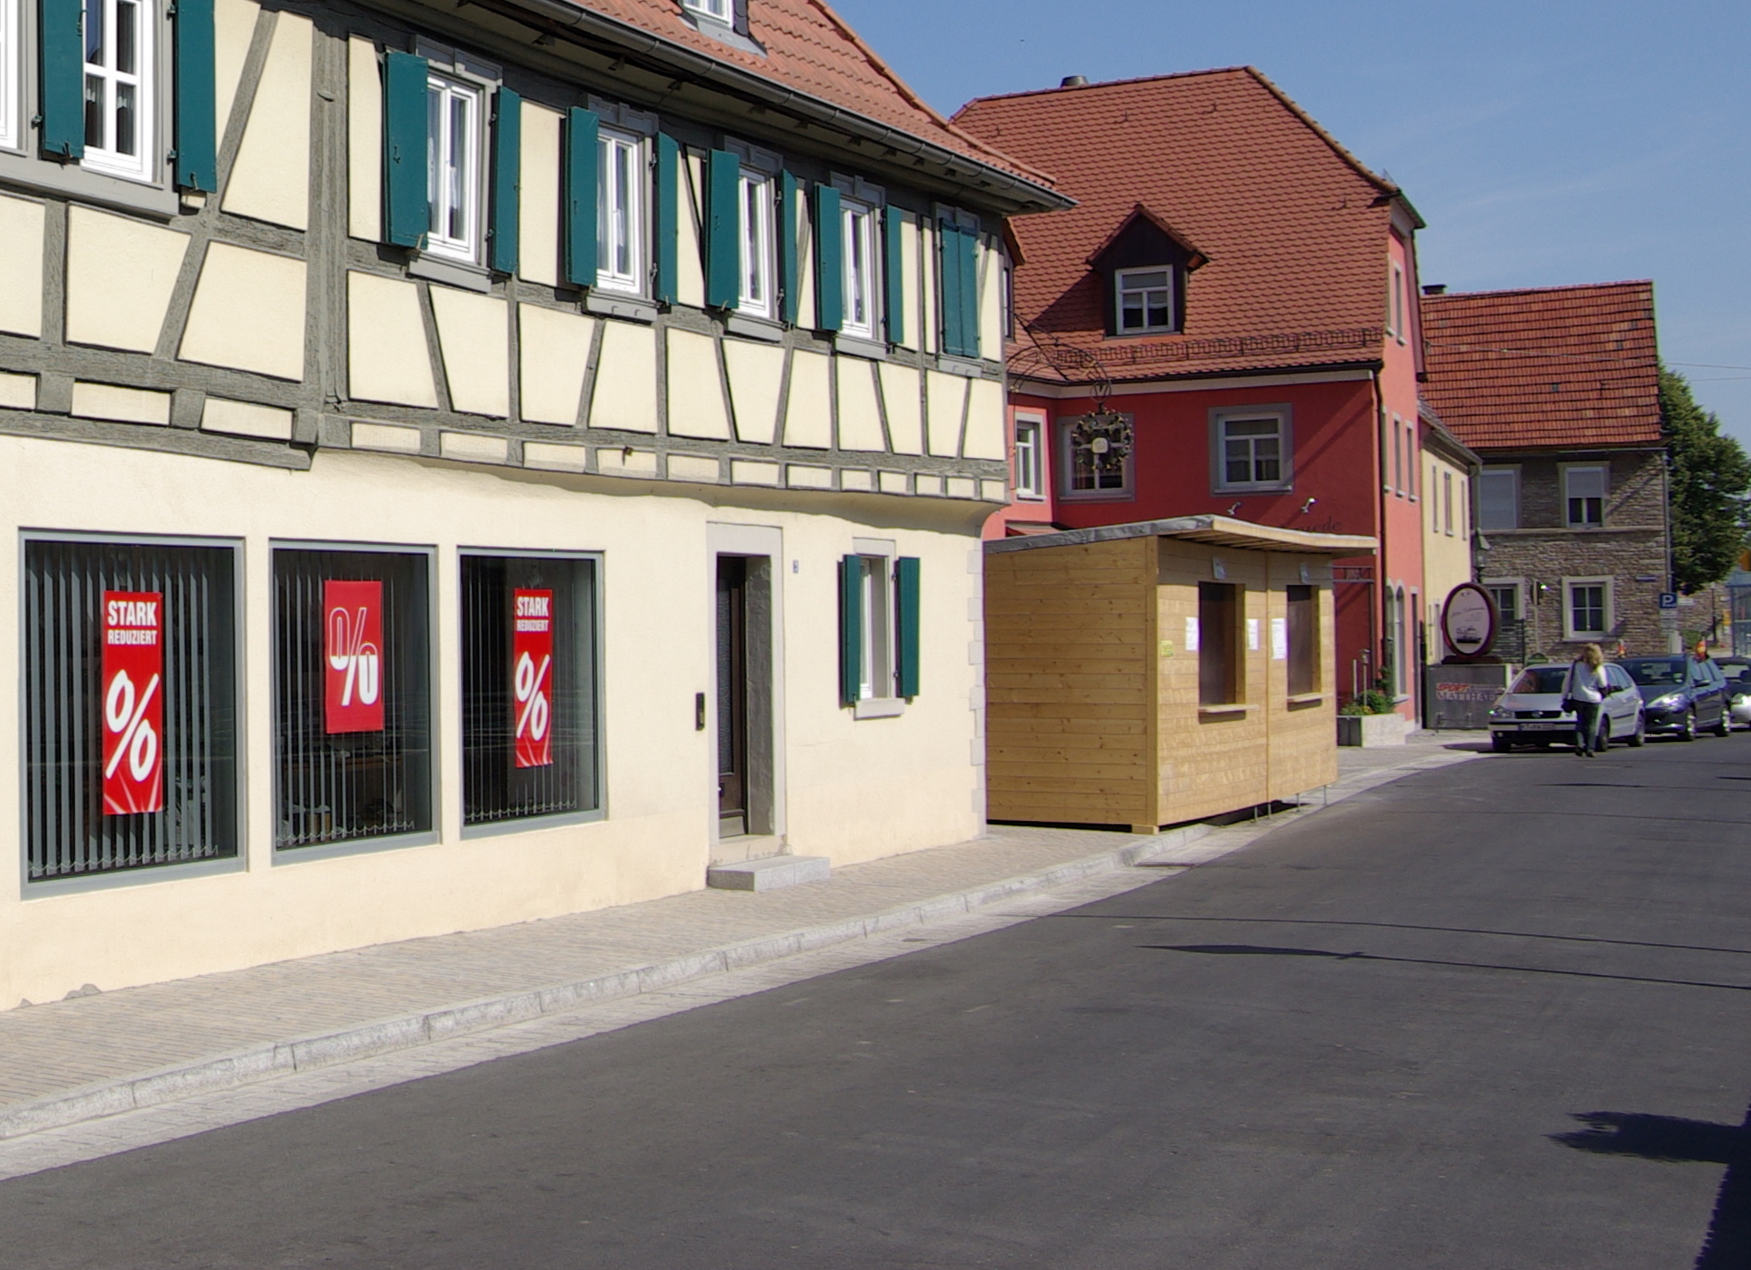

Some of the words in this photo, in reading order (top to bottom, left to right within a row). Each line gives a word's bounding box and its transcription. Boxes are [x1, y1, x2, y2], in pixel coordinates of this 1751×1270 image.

[517, 596, 549, 617] STARK
[1663, 594, 1675, 607] P
[107, 600, 157, 627] STARK
[107, 629, 157, 645] REDUZIERT
[329, 607, 379, 707] %
[514, 651, 551, 742] %
[1436, 683, 1471, 692] SPORT
[105, 669, 159, 782] %
